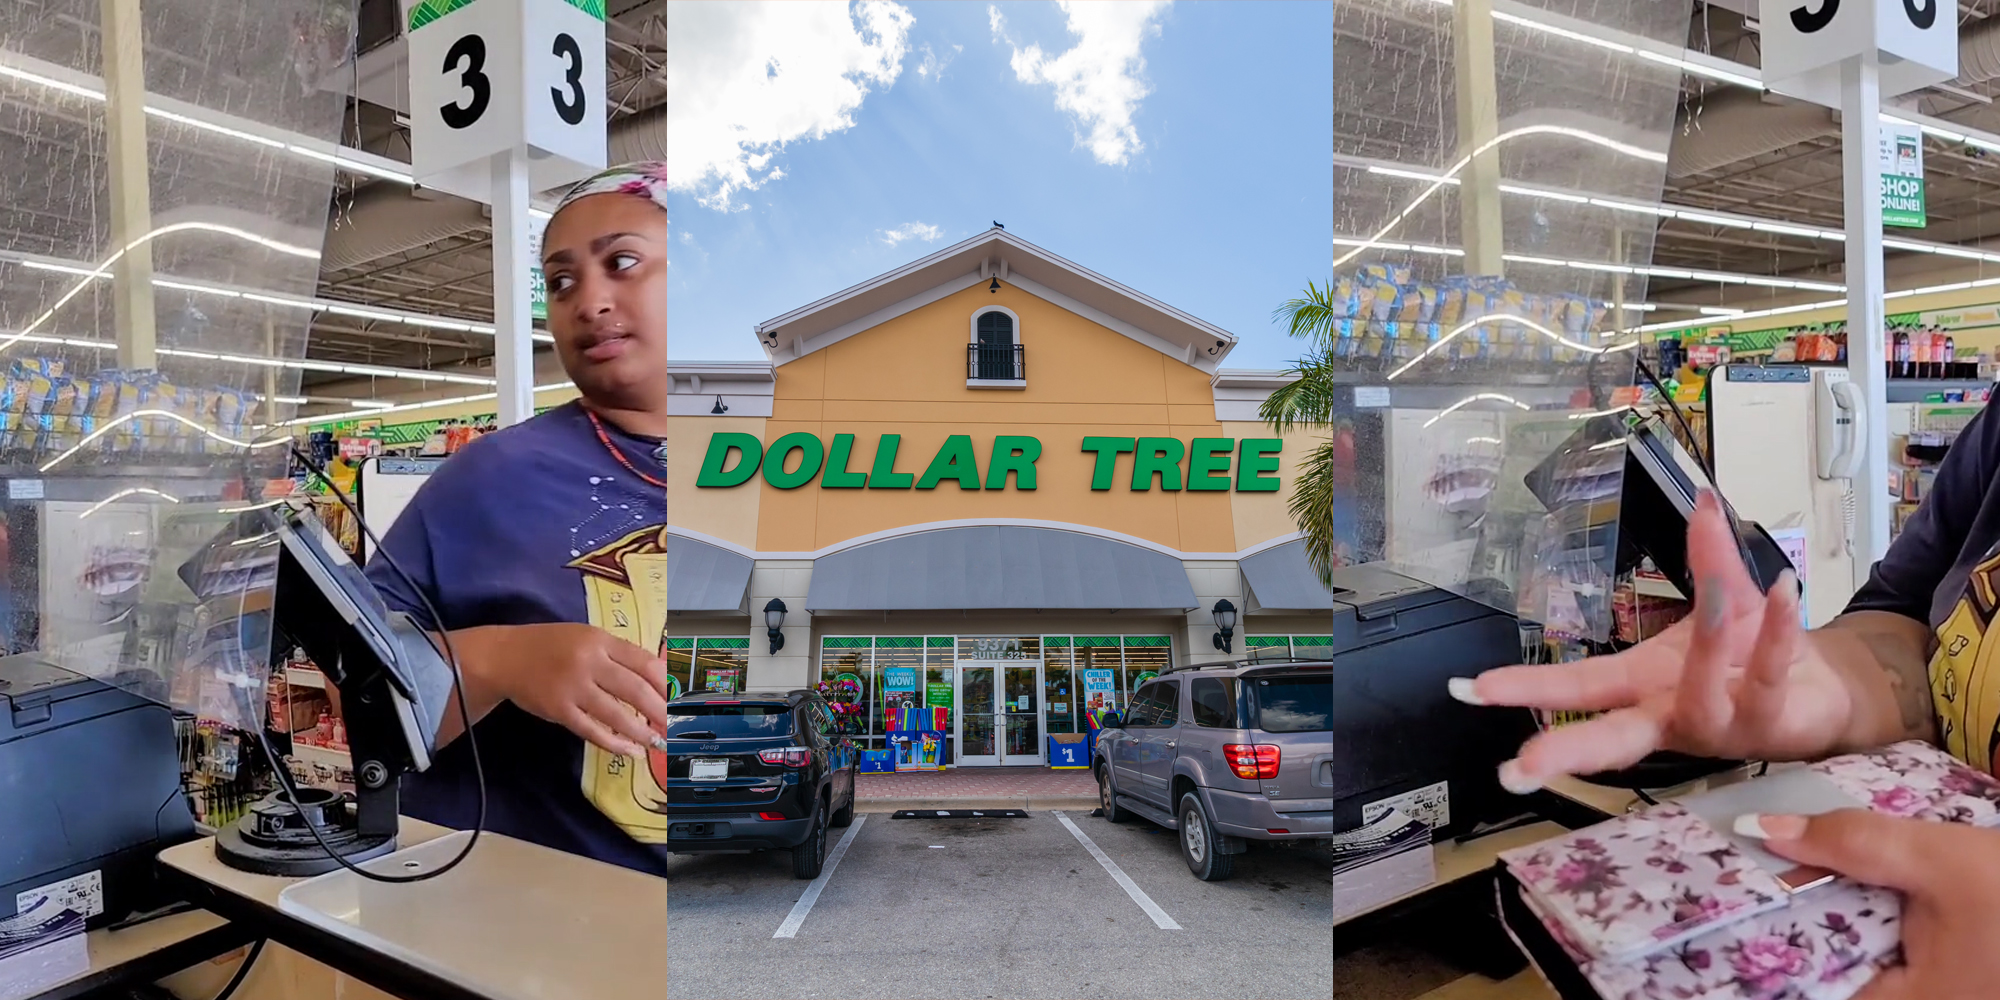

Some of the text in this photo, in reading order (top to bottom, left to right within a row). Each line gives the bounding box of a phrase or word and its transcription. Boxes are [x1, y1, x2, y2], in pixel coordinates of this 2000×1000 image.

[440, 34, 491, 129] 3
[551, 32, 586, 126] 3
[1881, 177, 1919, 198] SHOP
[1881, 197, 1920, 212] ONLINE!
[695, 432, 1284, 492] DOLLAR TREE
[978, 637, 1019, 651] 9371
[971, 651, 1027, 660] SUITE 325
[886, 676, 914, 687] WOW!
[1087, 682, 1112, 690] WEEK!
[699, 743, 720, 752] Jeep
[1062, 747, 1075, 762] $1
[875, 761, 882, 770] $1
[1364, 803, 1385, 814] EPSON
[18, 891, 39, 902] EPSON
